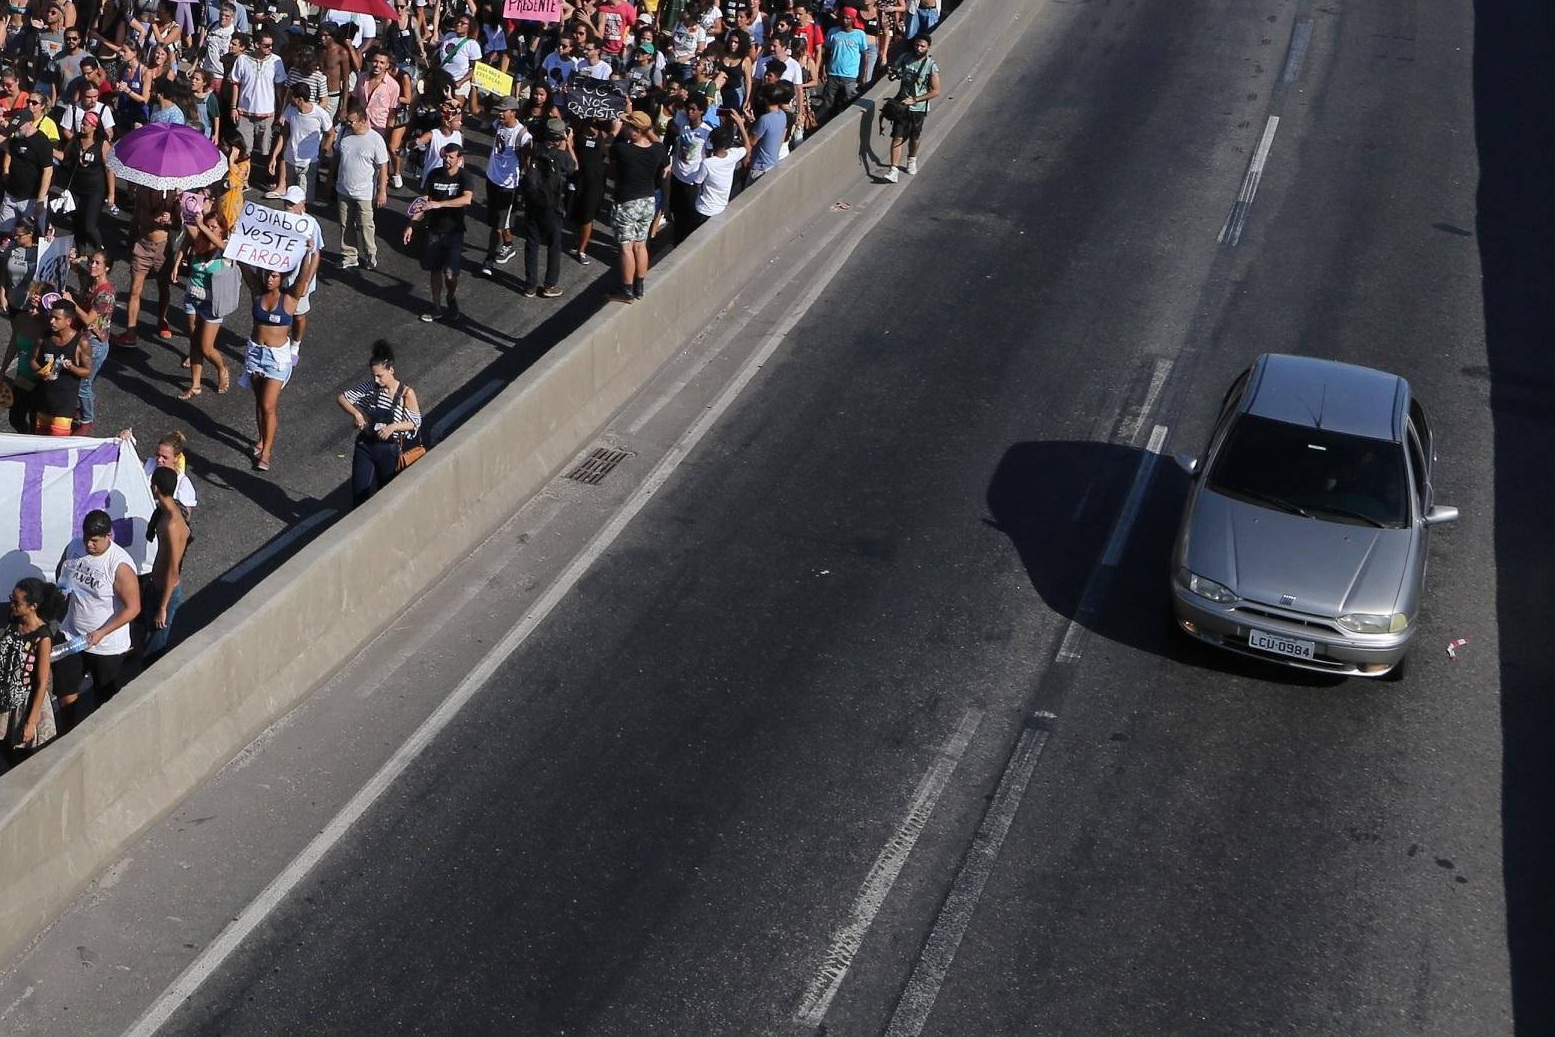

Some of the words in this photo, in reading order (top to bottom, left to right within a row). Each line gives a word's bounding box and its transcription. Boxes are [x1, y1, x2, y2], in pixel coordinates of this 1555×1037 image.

[582, 96, 611, 108] NOS
[245, 203, 255, 216] O
[236, 243, 290, 267] FARDA
